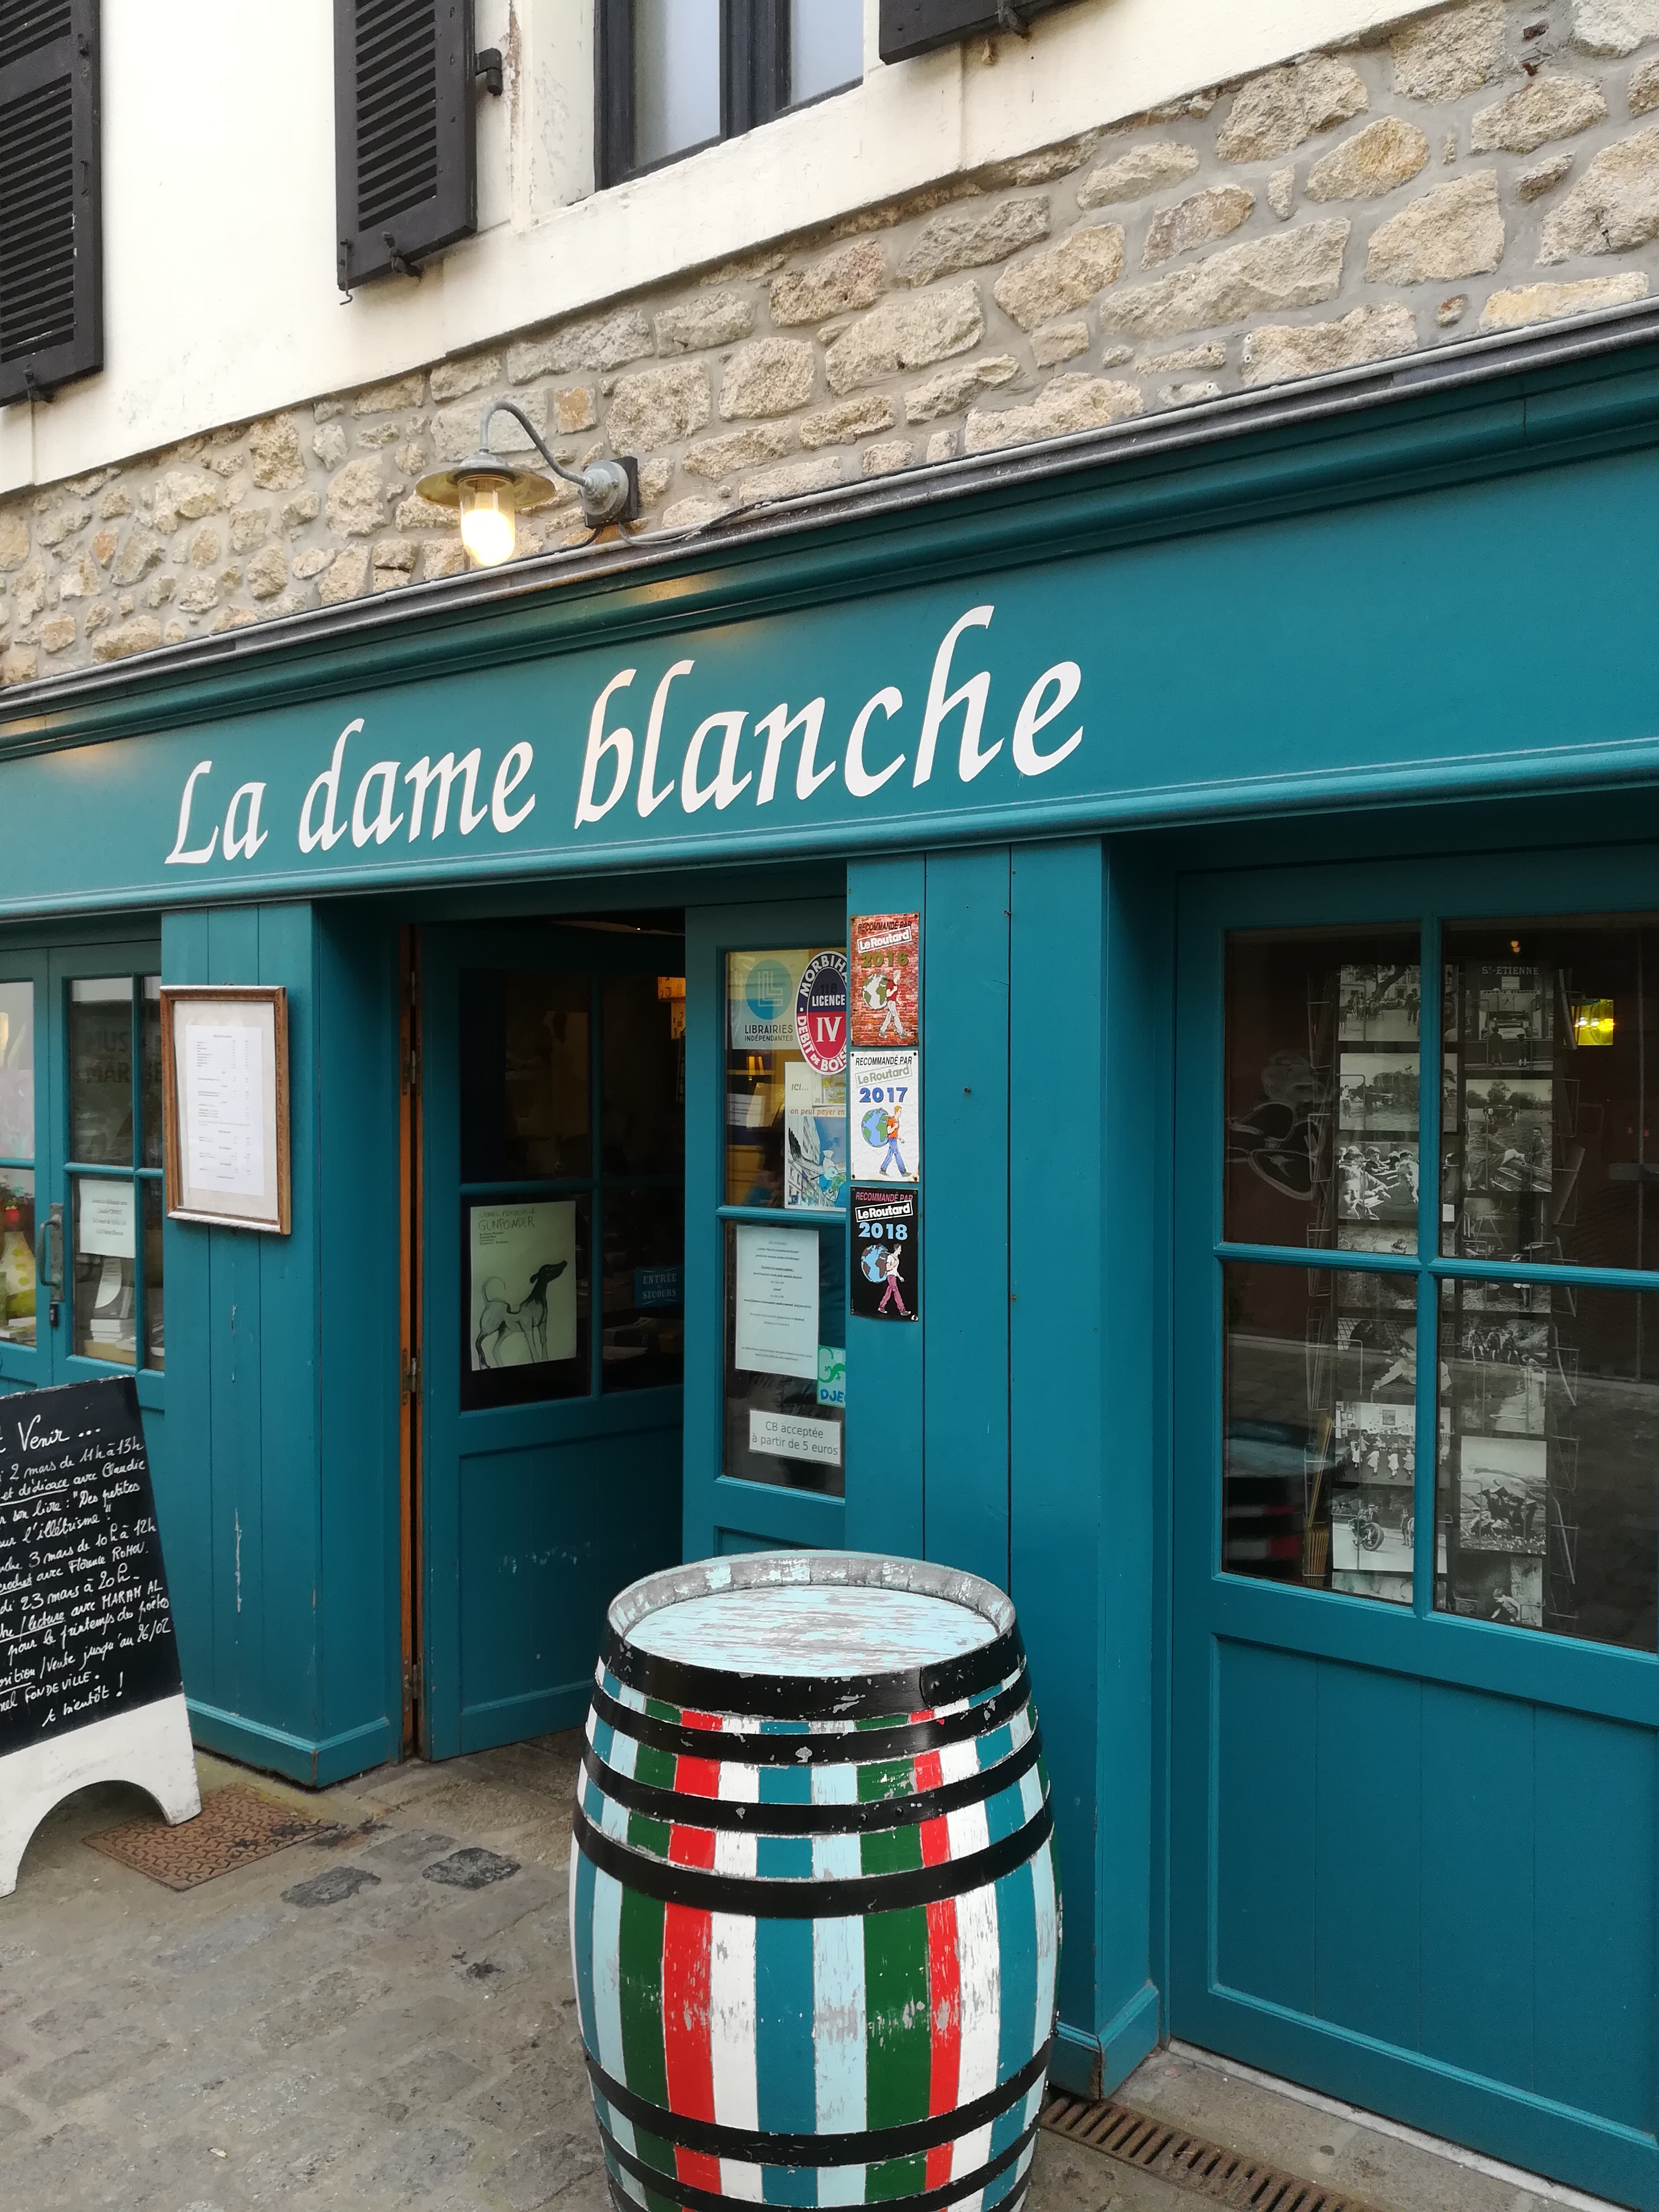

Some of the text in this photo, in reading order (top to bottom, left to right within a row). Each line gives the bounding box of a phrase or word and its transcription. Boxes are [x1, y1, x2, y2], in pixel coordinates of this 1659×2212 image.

[164, 605, 1083, 866] La dame blanche
[858, 920, 899, 932] RECOMMANDÉ
[861, 950, 909, 968] 2016
[812, 995, 845, 1007] LICENCE
[745, 1025, 793, 1034] LIBRAIRIES
[816, 1017, 842, 1042] IV
[798, 1016, 814, 1054] DEBIT
[810, 1053, 820, 1065] DE
[855, 1055, 912, 1065] RECOMMANDÉ PAR
[859, 1087, 908, 1103] 2017
[855, 1192, 898, 1202] RECOMMANDÉ
[858, 1222, 908, 1240] 2018
[643, 1272, 677, 1284] ENTRÉE
[643, 1288, 677, 1299] SECOURS
[18, 1414, 70, 1452] Venir
[765, 1421, 823, 1438] CB acceptée
[760, 1437, 785, 1446] partir
[788, 1439, 799, 1449] de
[803, 1441, 808, 1451] 5
[812, 1444, 838, 1456] euros
[9, 1463, 20, 1479] 2
[24, 1461, 56, 1479] mars
[32, 1499, 62, 1517] livre
[102, 1479, 140, 1508] petites
[28, 1551, 41, 1568] 3
[43, 1546, 74, 1564] mars
[147, 1579, 163, 1595] AL
[20, 1593, 45, 1611] 23
[47, 1584, 80, 1604] mars
[8, 1639, 38, 1666] pour
[63, 1685, 110, 1716] bientôt
